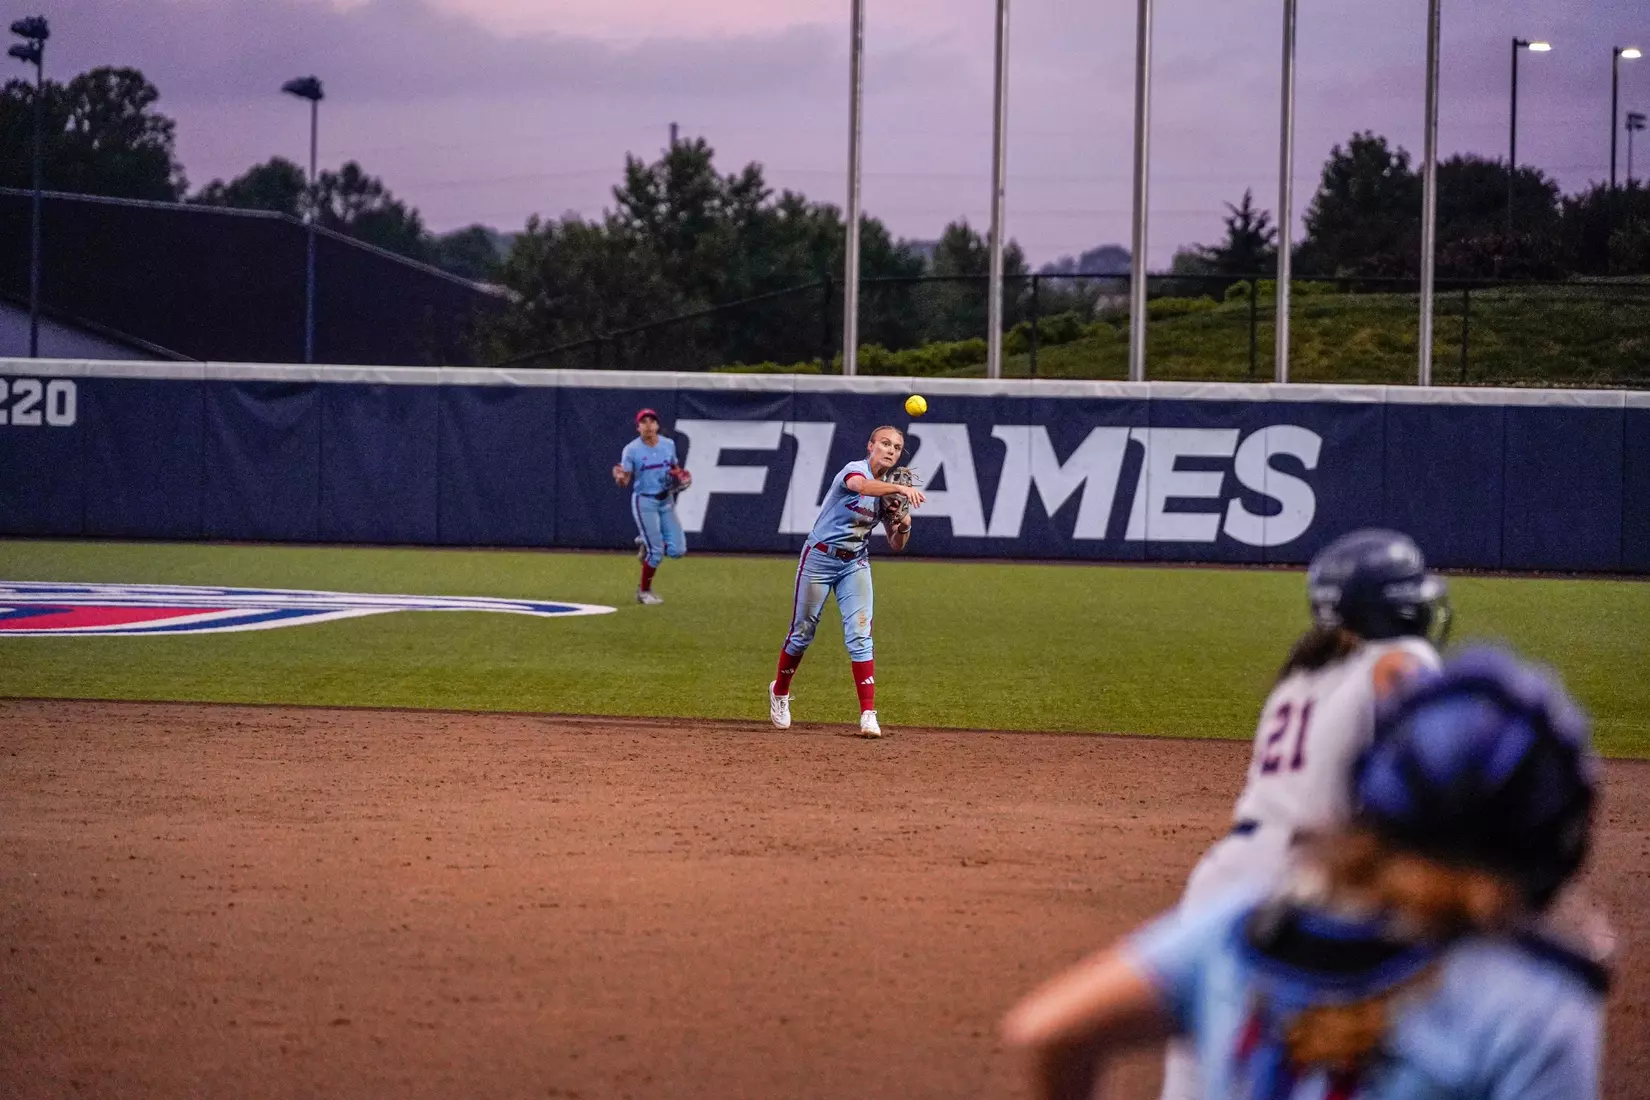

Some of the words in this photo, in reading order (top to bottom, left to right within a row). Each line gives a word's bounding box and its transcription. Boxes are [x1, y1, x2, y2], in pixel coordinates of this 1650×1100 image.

[0, 378, 76, 426] 20
[674, 419, 1322, 546] FLAMES
[1260, 701, 1314, 774] 21
